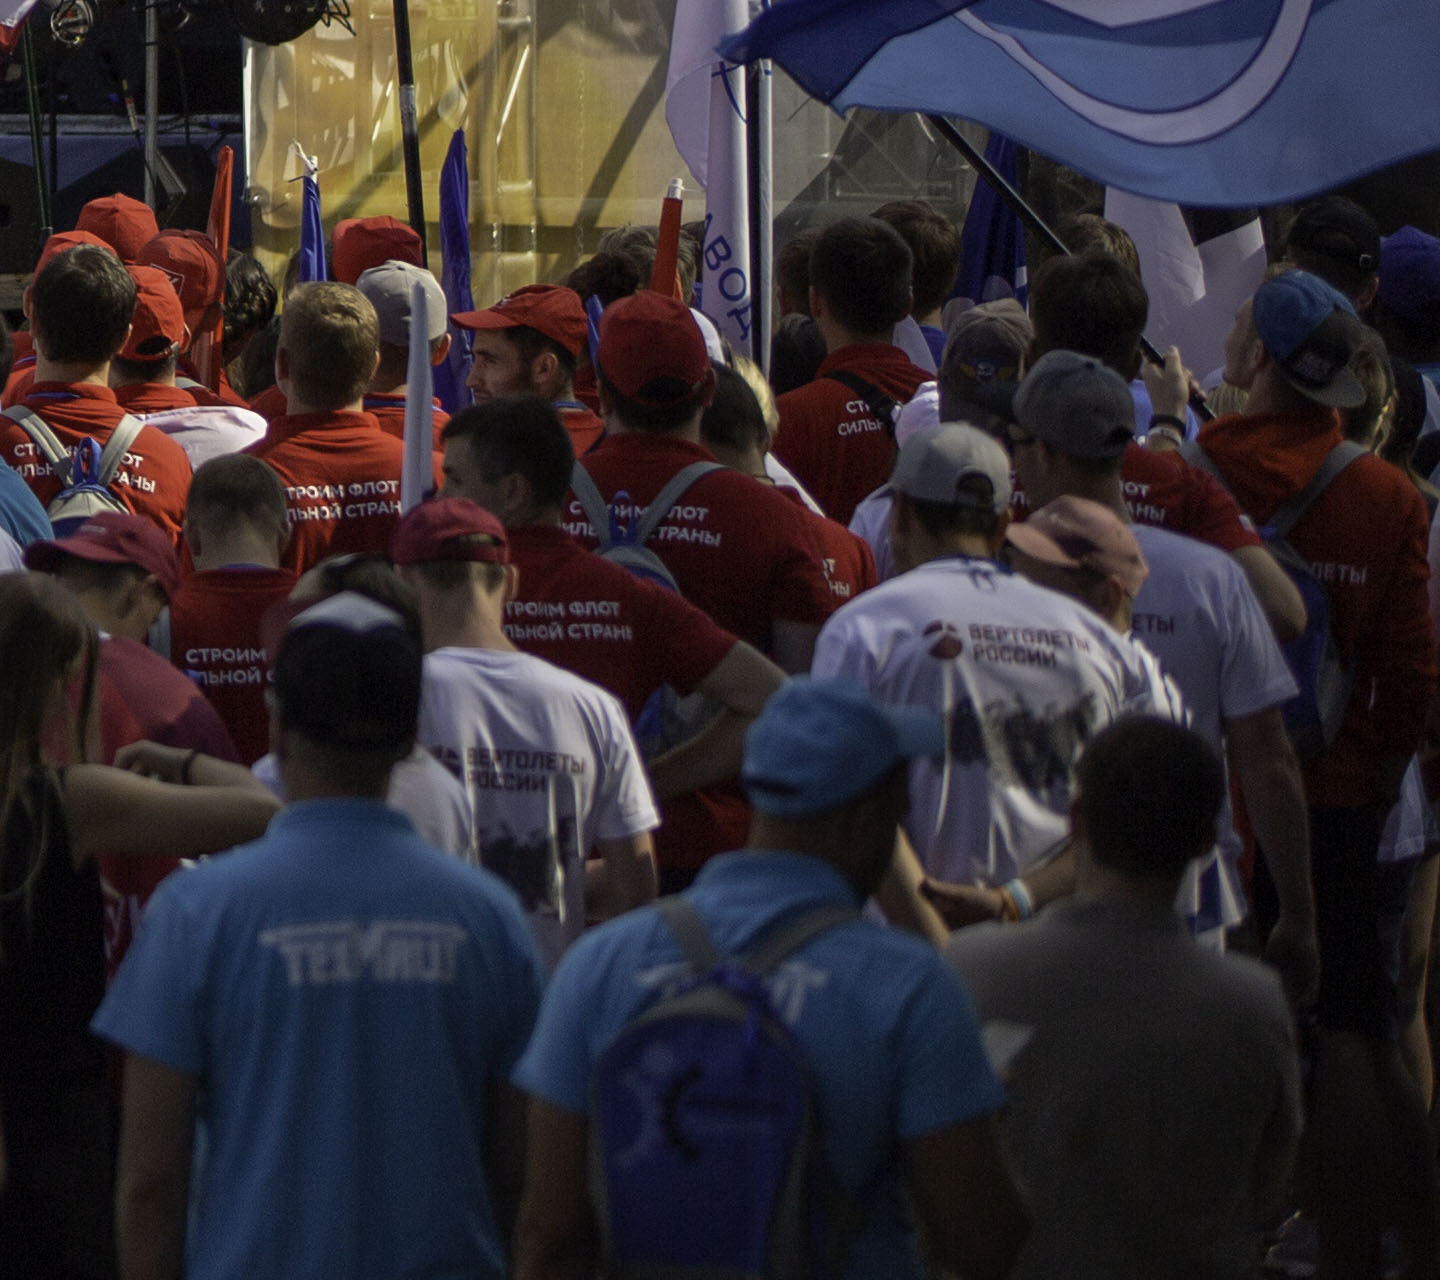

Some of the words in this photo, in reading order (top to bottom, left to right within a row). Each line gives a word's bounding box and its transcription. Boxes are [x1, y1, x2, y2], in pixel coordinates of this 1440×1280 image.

[287, 484, 345, 500] ТРОИМ
[348, 480, 399, 496] ФЛОТ
[345, 500, 403, 518] СТРАН
[505, 600, 564, 618] ТРОИМ
[568, 600, 621, 618] ФЛОТ
[969, 624, 1091, 653] ВЕРТОЛЕТЫ
[184, 647, 268, 664] СТРОИМ
[973, 647, 1059, 669] РОССИИ
[467, 749, 586, 775] ВЕРТОЛЕТЫ
